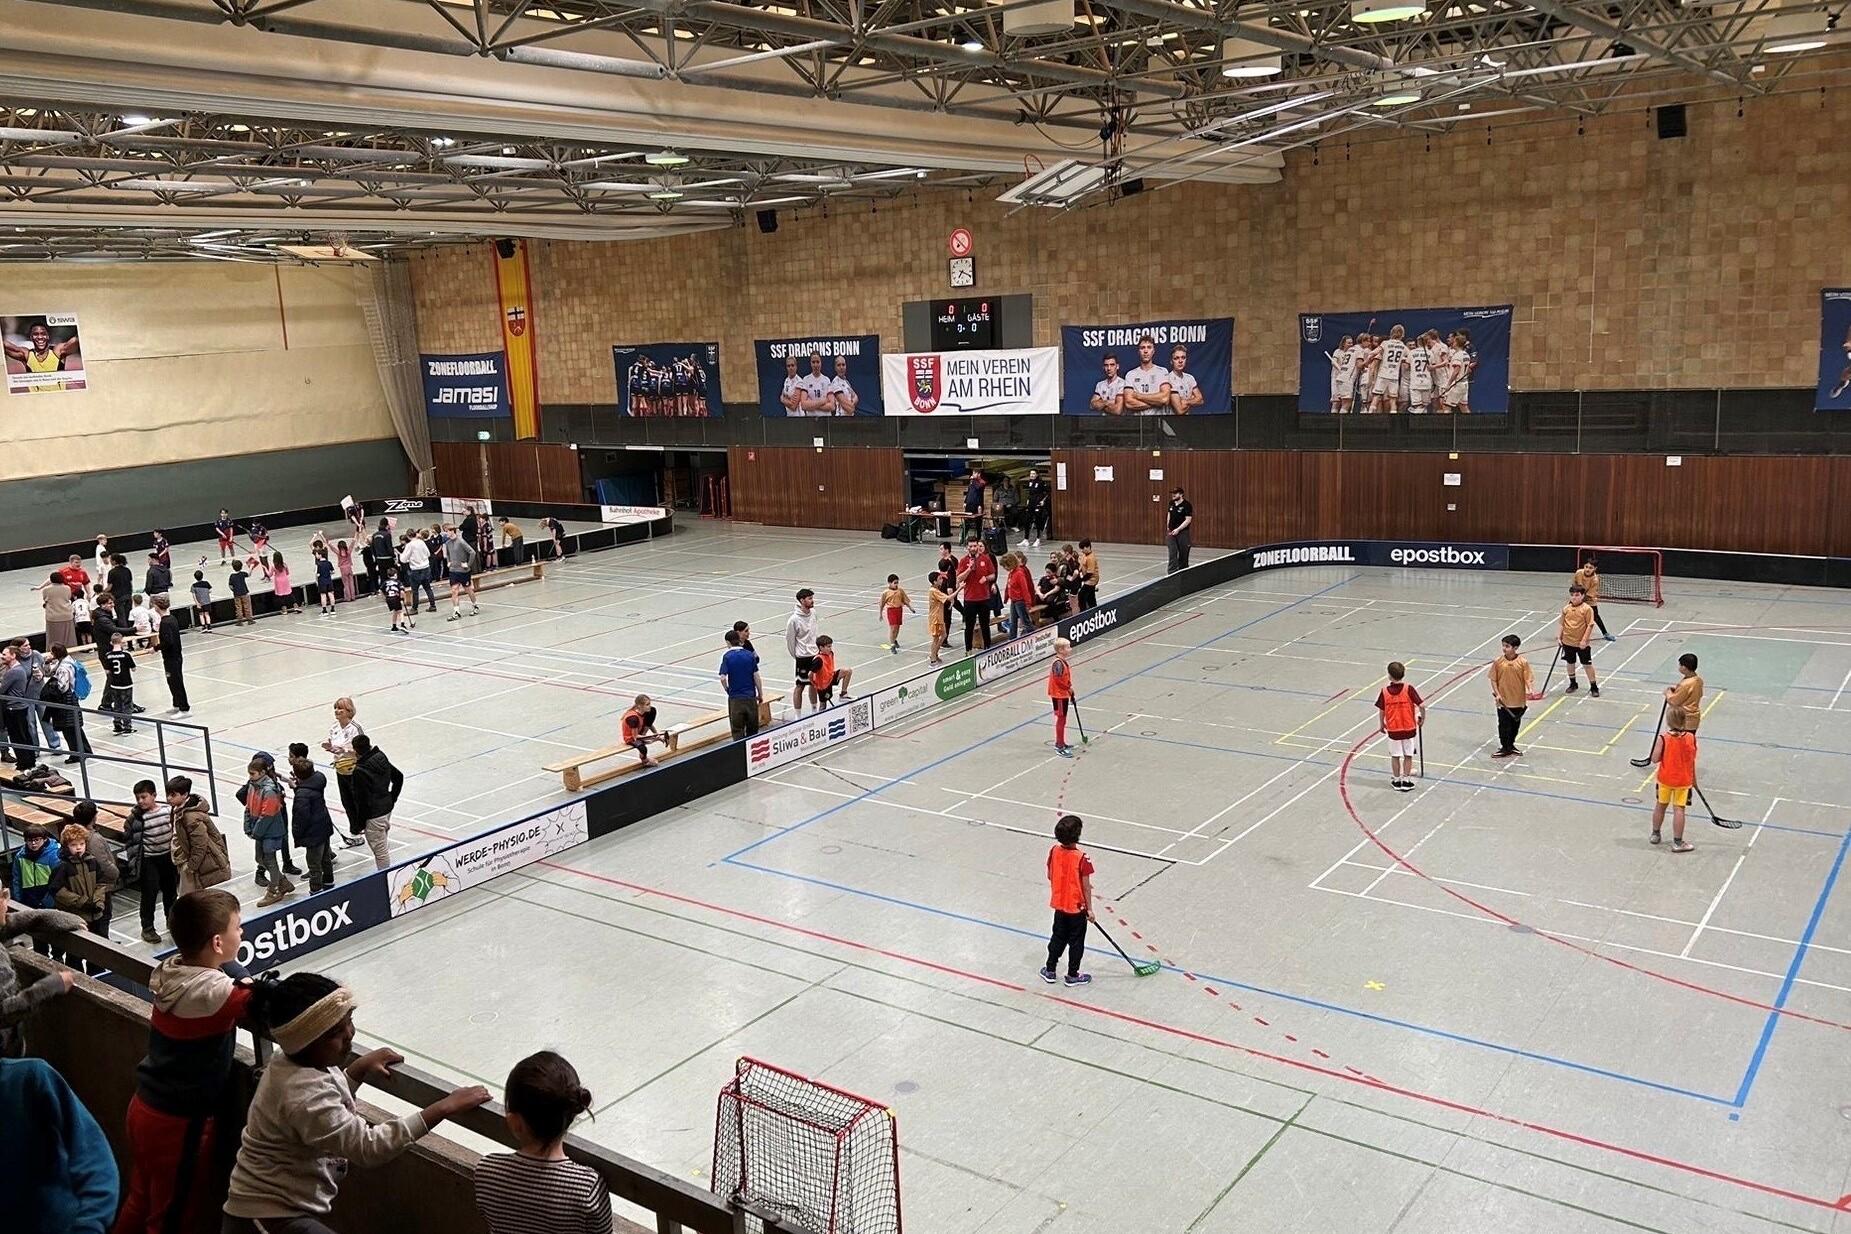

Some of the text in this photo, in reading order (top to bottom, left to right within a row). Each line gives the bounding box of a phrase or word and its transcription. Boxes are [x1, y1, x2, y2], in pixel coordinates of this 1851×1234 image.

[1082, 325, 1207, 347] SSF DRAGONS BONN
[770, 340, 860, 358] SSF DRAGONS BONN
[912, 358, 934, 370] SSF
[947, 358, 1030, 376] MEIN VEREIN
[948, 376, 1031, 398] AM RHEIN
[914, 397, 937, 409] BONN
[1390, 547, 1485, 564] epostbox
[1069, 609, 1117, 642] epostbox
[988, 644, 1020, 668] FLOORBALL
[1022, 638, 1034, 654] DM
[112, 660, 121, 674] 3
[942, 674, 955, 682] smart
[956, 669, 961, 680] &
[880, 682, 928, 712] green capital
[772, 738, 798, 754] Sliwa
[800, 732, 806, 744] &
[809, 727, 826, 742] Bau
[455, 826, 540, 868] WERDE-PHYSIO.DE
[467, 846, 530, 874] Schule für Physiotherapie
[497, 861, 511, 870] Bonn
